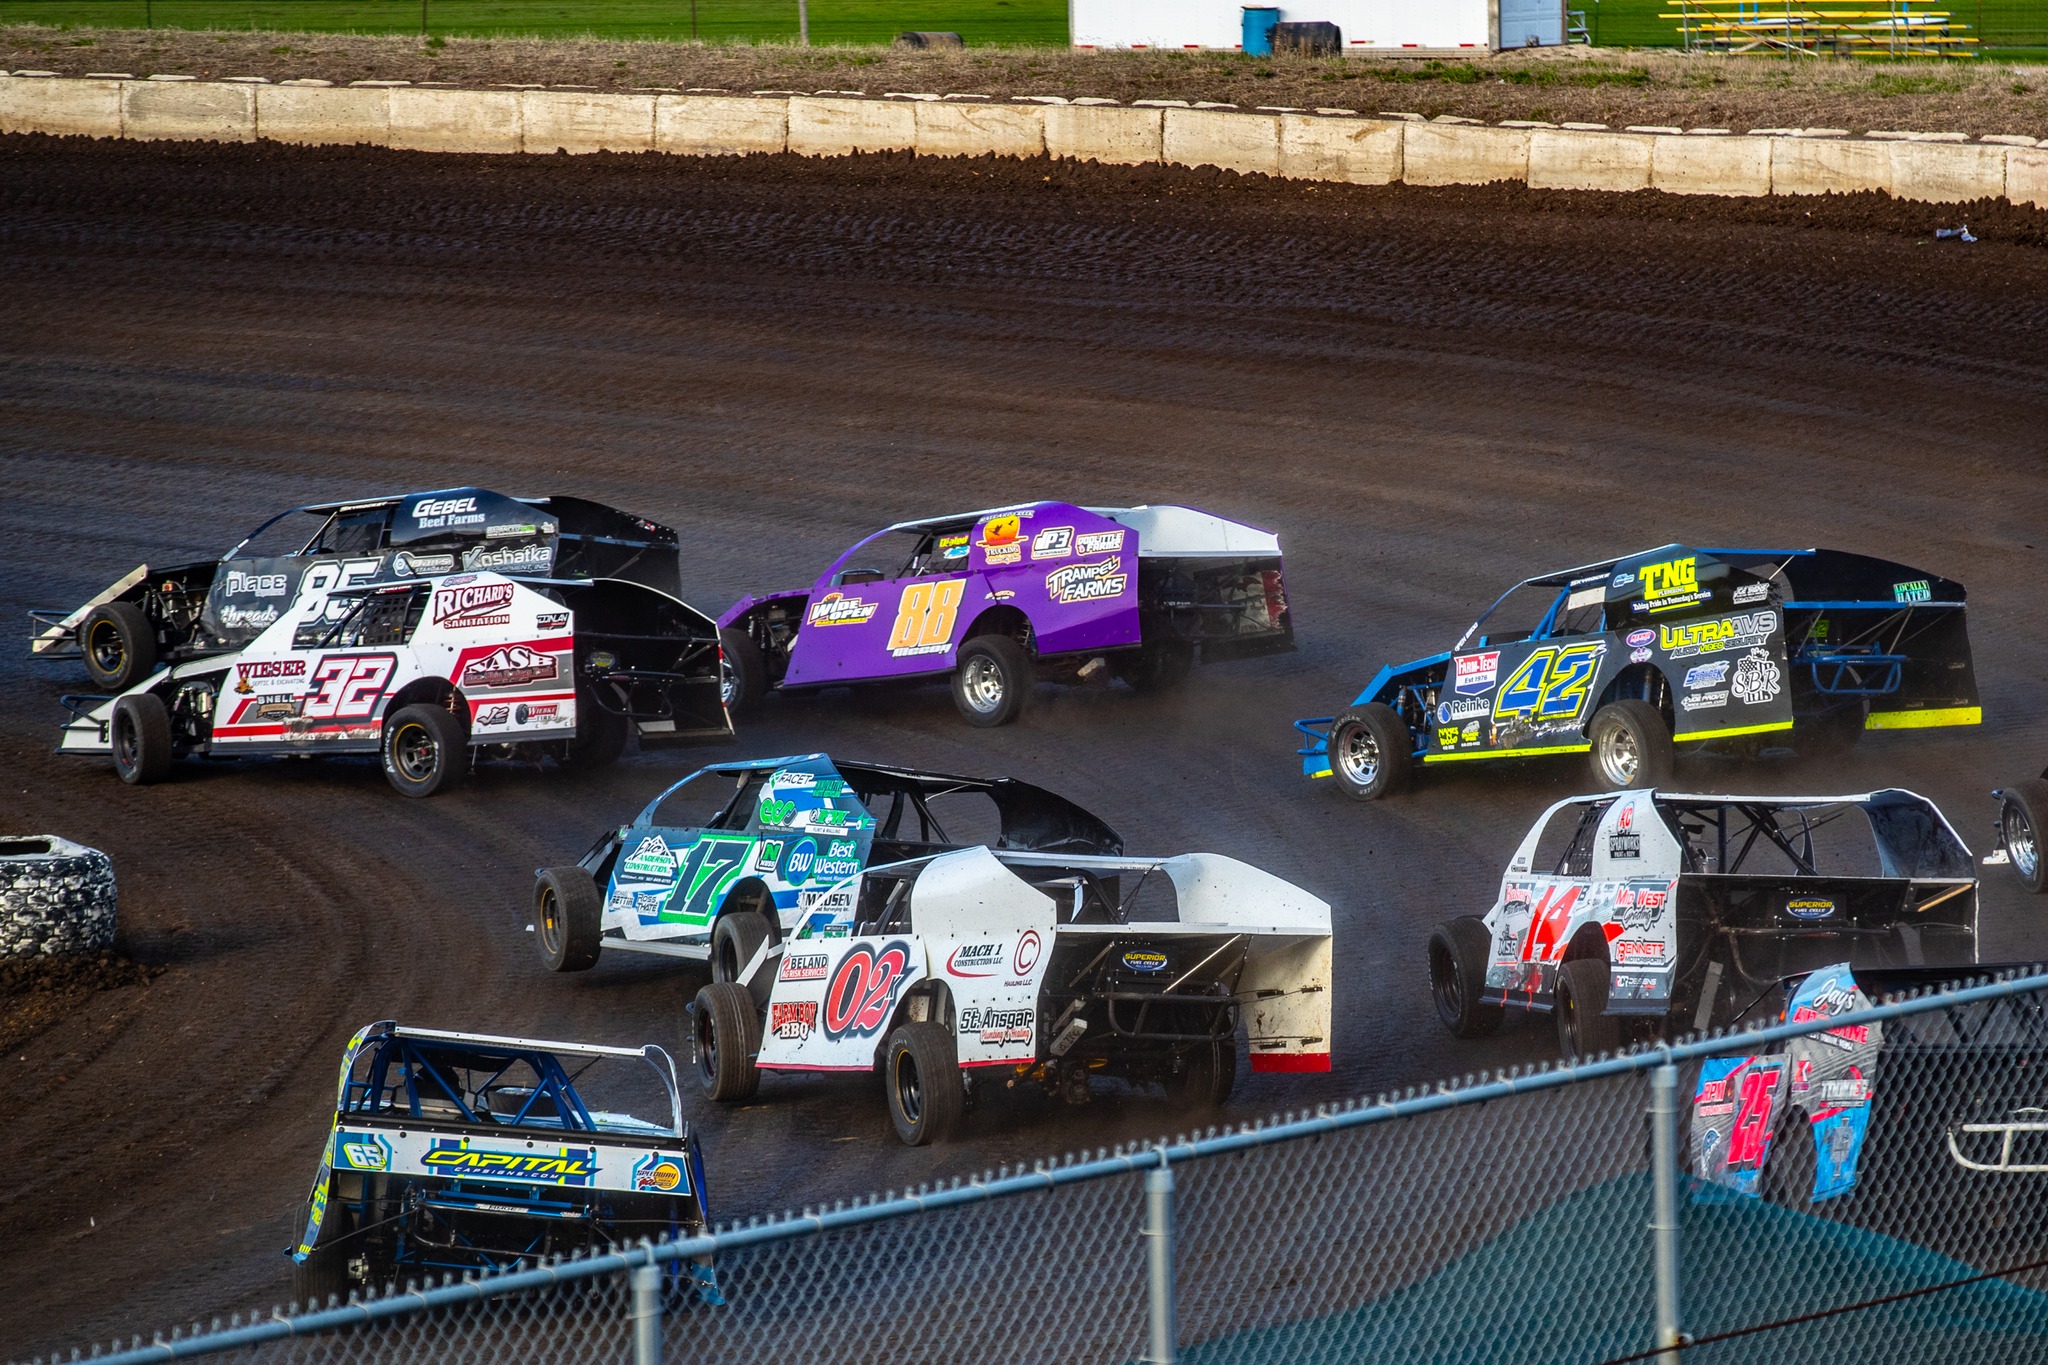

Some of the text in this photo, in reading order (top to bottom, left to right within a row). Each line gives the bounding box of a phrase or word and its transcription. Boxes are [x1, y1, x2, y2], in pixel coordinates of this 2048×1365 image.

[412, 497, 477, 518] GEBEL
[418, 513, 485, 529] Beef Farms
[462, 544, 552, 569] Koshatka
[1048, 558, 1119, 597] TRAMPEL
[1639, 556, 1698, 601] TNG
[1895, 582, 1928, 592] LOCALLY
[1062, 576, 1124, 602] FARMS
[1897, 590, 1930, 602] HATED
[433, 582, 514, 626] RICHARD'S
[810, 599, 860, 621] WIDE
[828, 606, 875, 621] OPEN
[444, 614, 510, 629] SANITATION
[887, 579, 967, 651] 88
[1700, 641, 1724, 652] VIDEO
[1725, 635, 1765, 648] SECURITY
[236, 660, 306, 678] WIESER
[467, 647, 553, 674] NASB
[302, 653, 398, 722] 32
[1495, 649, 1601, 722] 42
[1453, 699, 1489, 713] Reinke
[829, 842, 854, 857] Best
[788, 853, 813, 872] BW
[814, 858, 858, 874] Western
[663, 838, 751, 917] 17
[1615, 887, 1666, 907] MID WEST
[1522, 885, 1583, 961] 14
[959, 943, 1003, 958] MACH 1
[1125, 953, 1166, 961] SUPERIOR
[1618, 942, 1664, 961] BENNETT
[791, 957, 827, 969] BELAND
[802, 967, 826, 976] SERVICES
[954, 959, 992, 967] CONSTRUCTION
[828, 950, 904, 1034] 02
[1813, 978, 1855, 1016] Jays
[981, 1007, 1033, 1029] Ansgar
[780, 1022, 808, 1039] BBQ
[1727, 1070, 1781, 1165] 25
[347, 1145, 383, 1168] 65
[425, 1151, 589, 1175] CAPITAL
[454, 1167, 559, 1180] CAPSIGNS.COM
